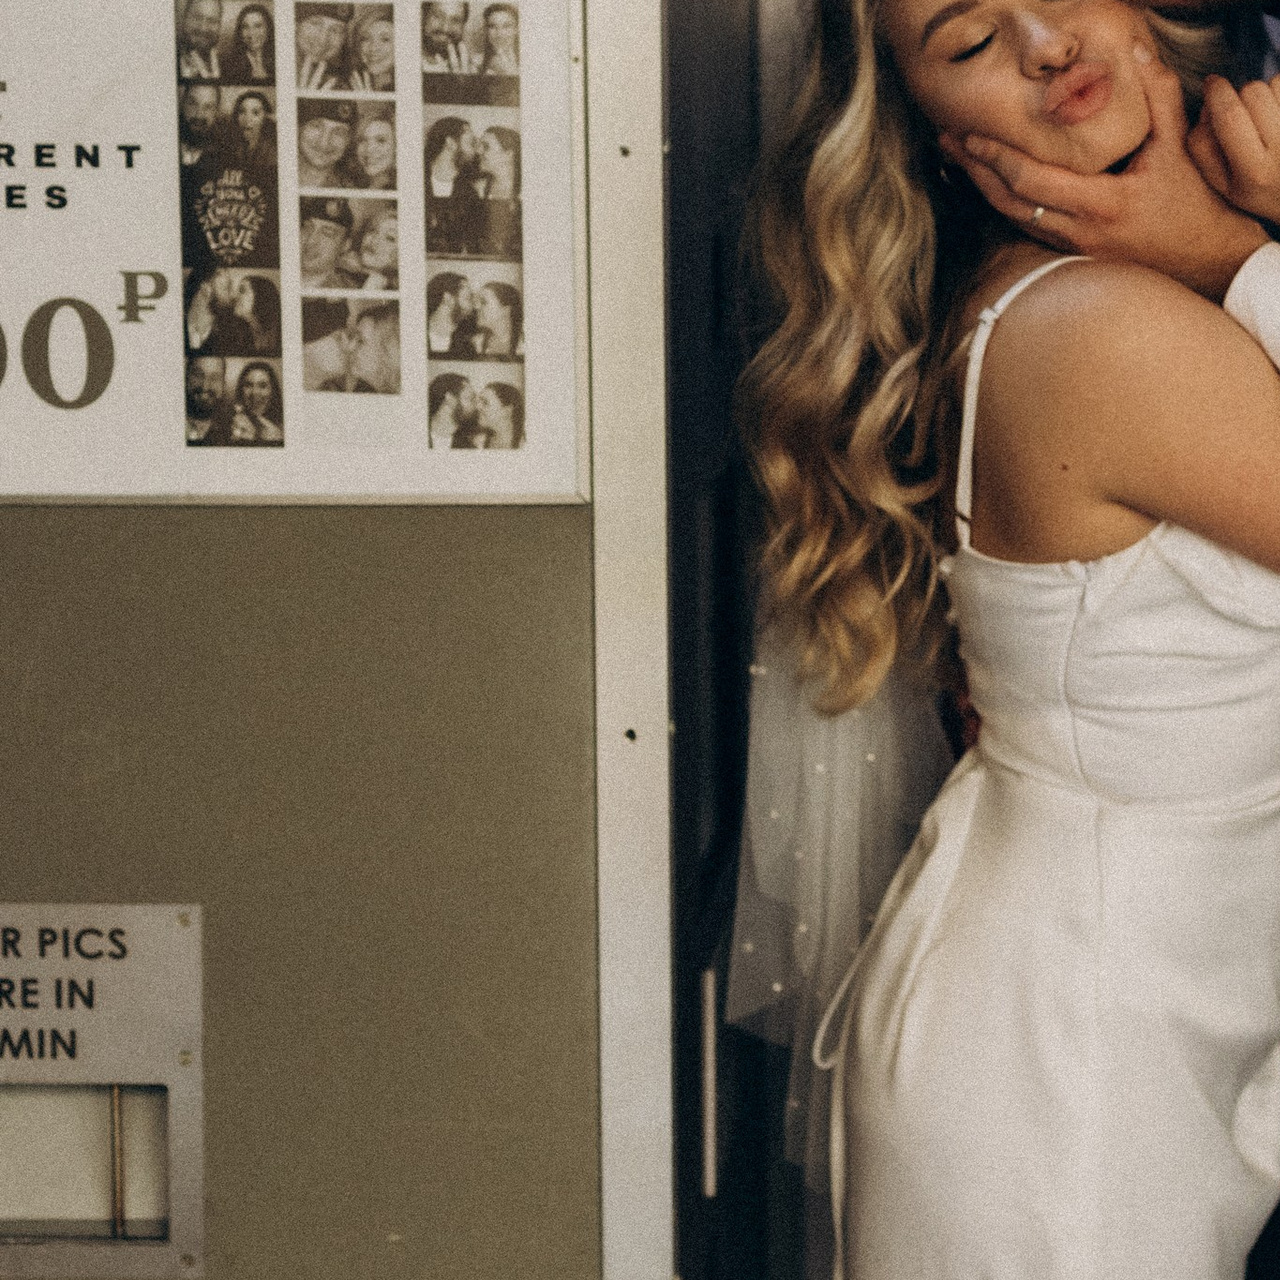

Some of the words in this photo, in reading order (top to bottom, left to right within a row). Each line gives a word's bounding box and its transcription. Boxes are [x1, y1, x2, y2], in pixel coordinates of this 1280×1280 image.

[5, 185, 68, 210] ES
[38, 927, 128, 960] PICS
[0, 978, 39, 1009] RE
[55, 978, 95, 1010] IN
[0, 1028, 77, 1059] MIN
